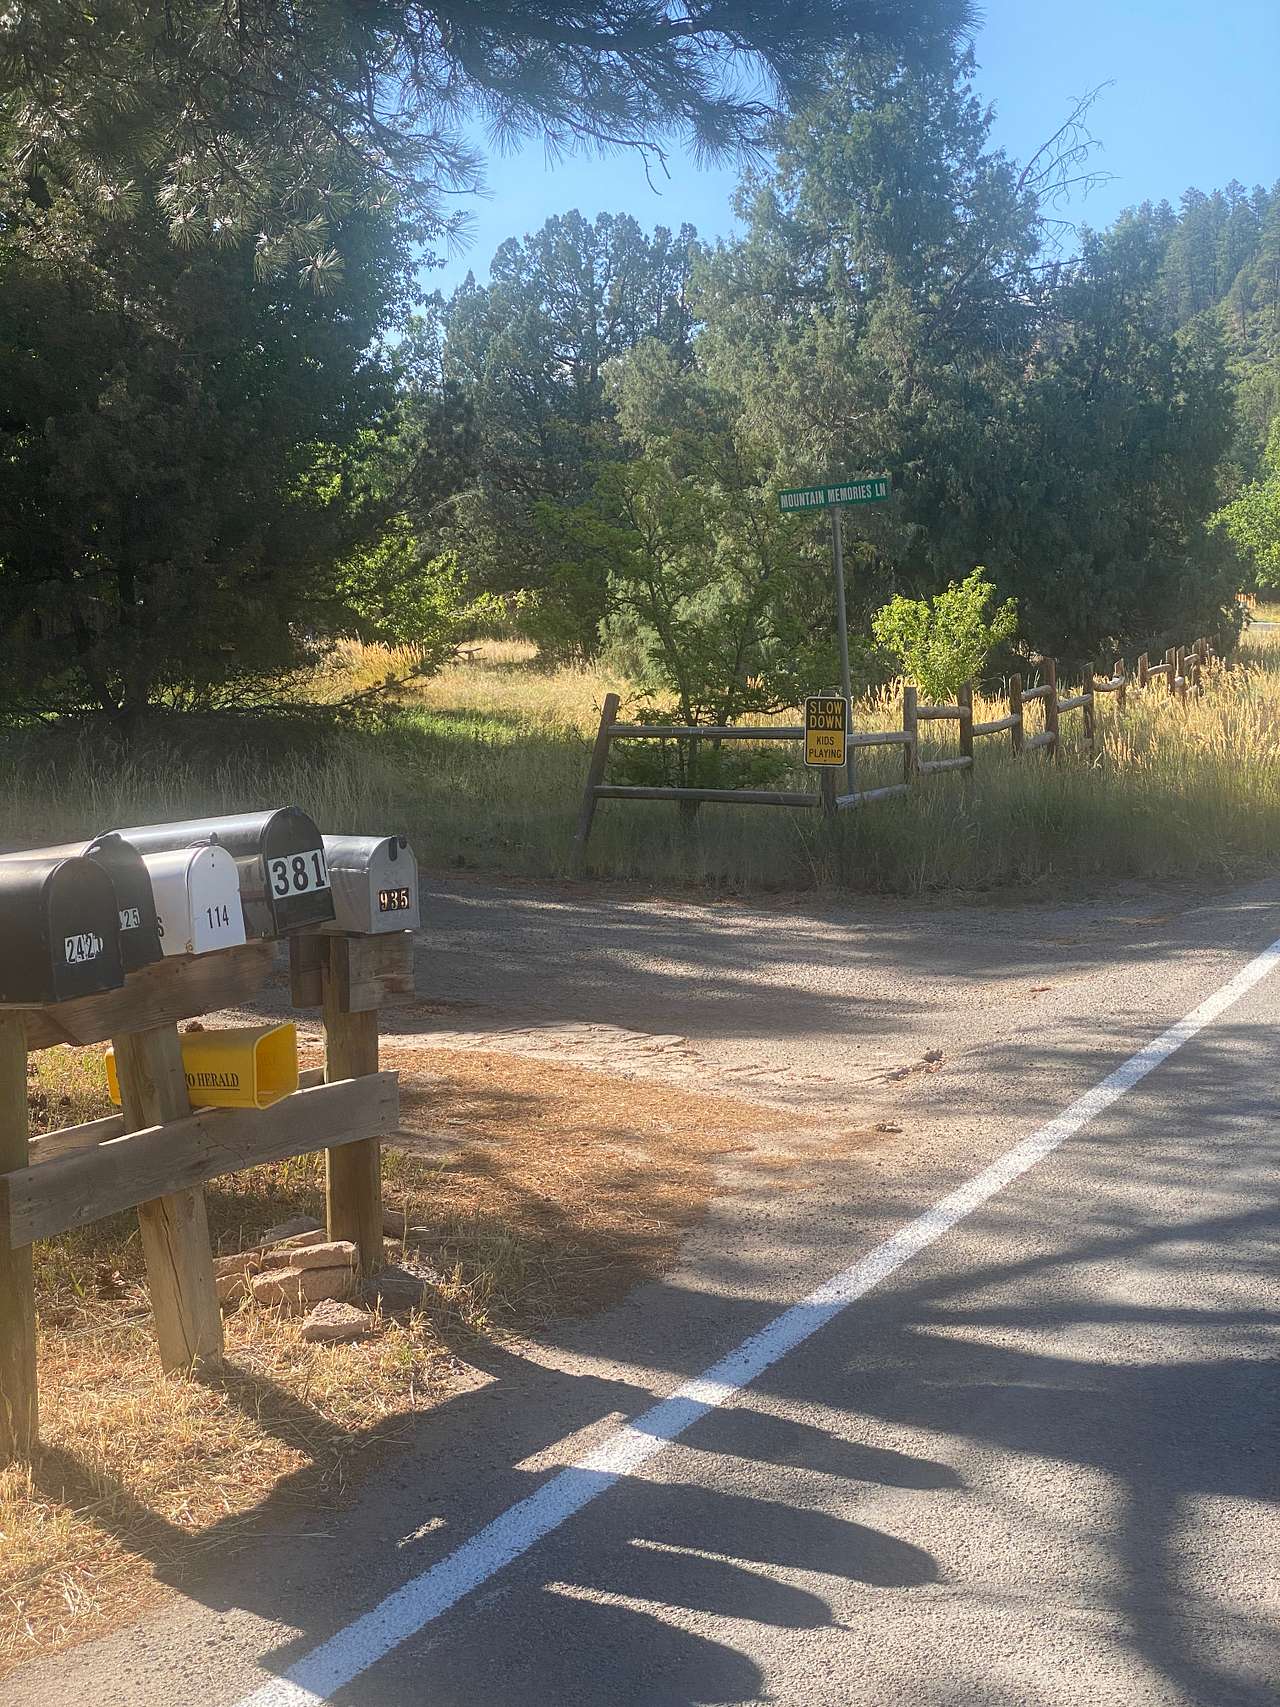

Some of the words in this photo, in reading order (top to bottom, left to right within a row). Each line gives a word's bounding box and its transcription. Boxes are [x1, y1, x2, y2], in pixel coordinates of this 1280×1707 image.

[781, 489, 825, 509] MOUNTAIN
[827, 484, 872, 503] MEMORIES
[874, 482, 886, 497] LN
[809, 701, 843, 714] SLOW
[809, 715, 842, 728] DOWN
[816, 735, 834, 746] KIDS
[808, 749, 842, 759] PLAYING
[272, 852, 326, 896] 381
[380, 890, 408, 911] 935
[120, 909, 139, 928] 25
[206, 905, 229, 929] 114
[197, 1071, 239, 1087] HERALD
